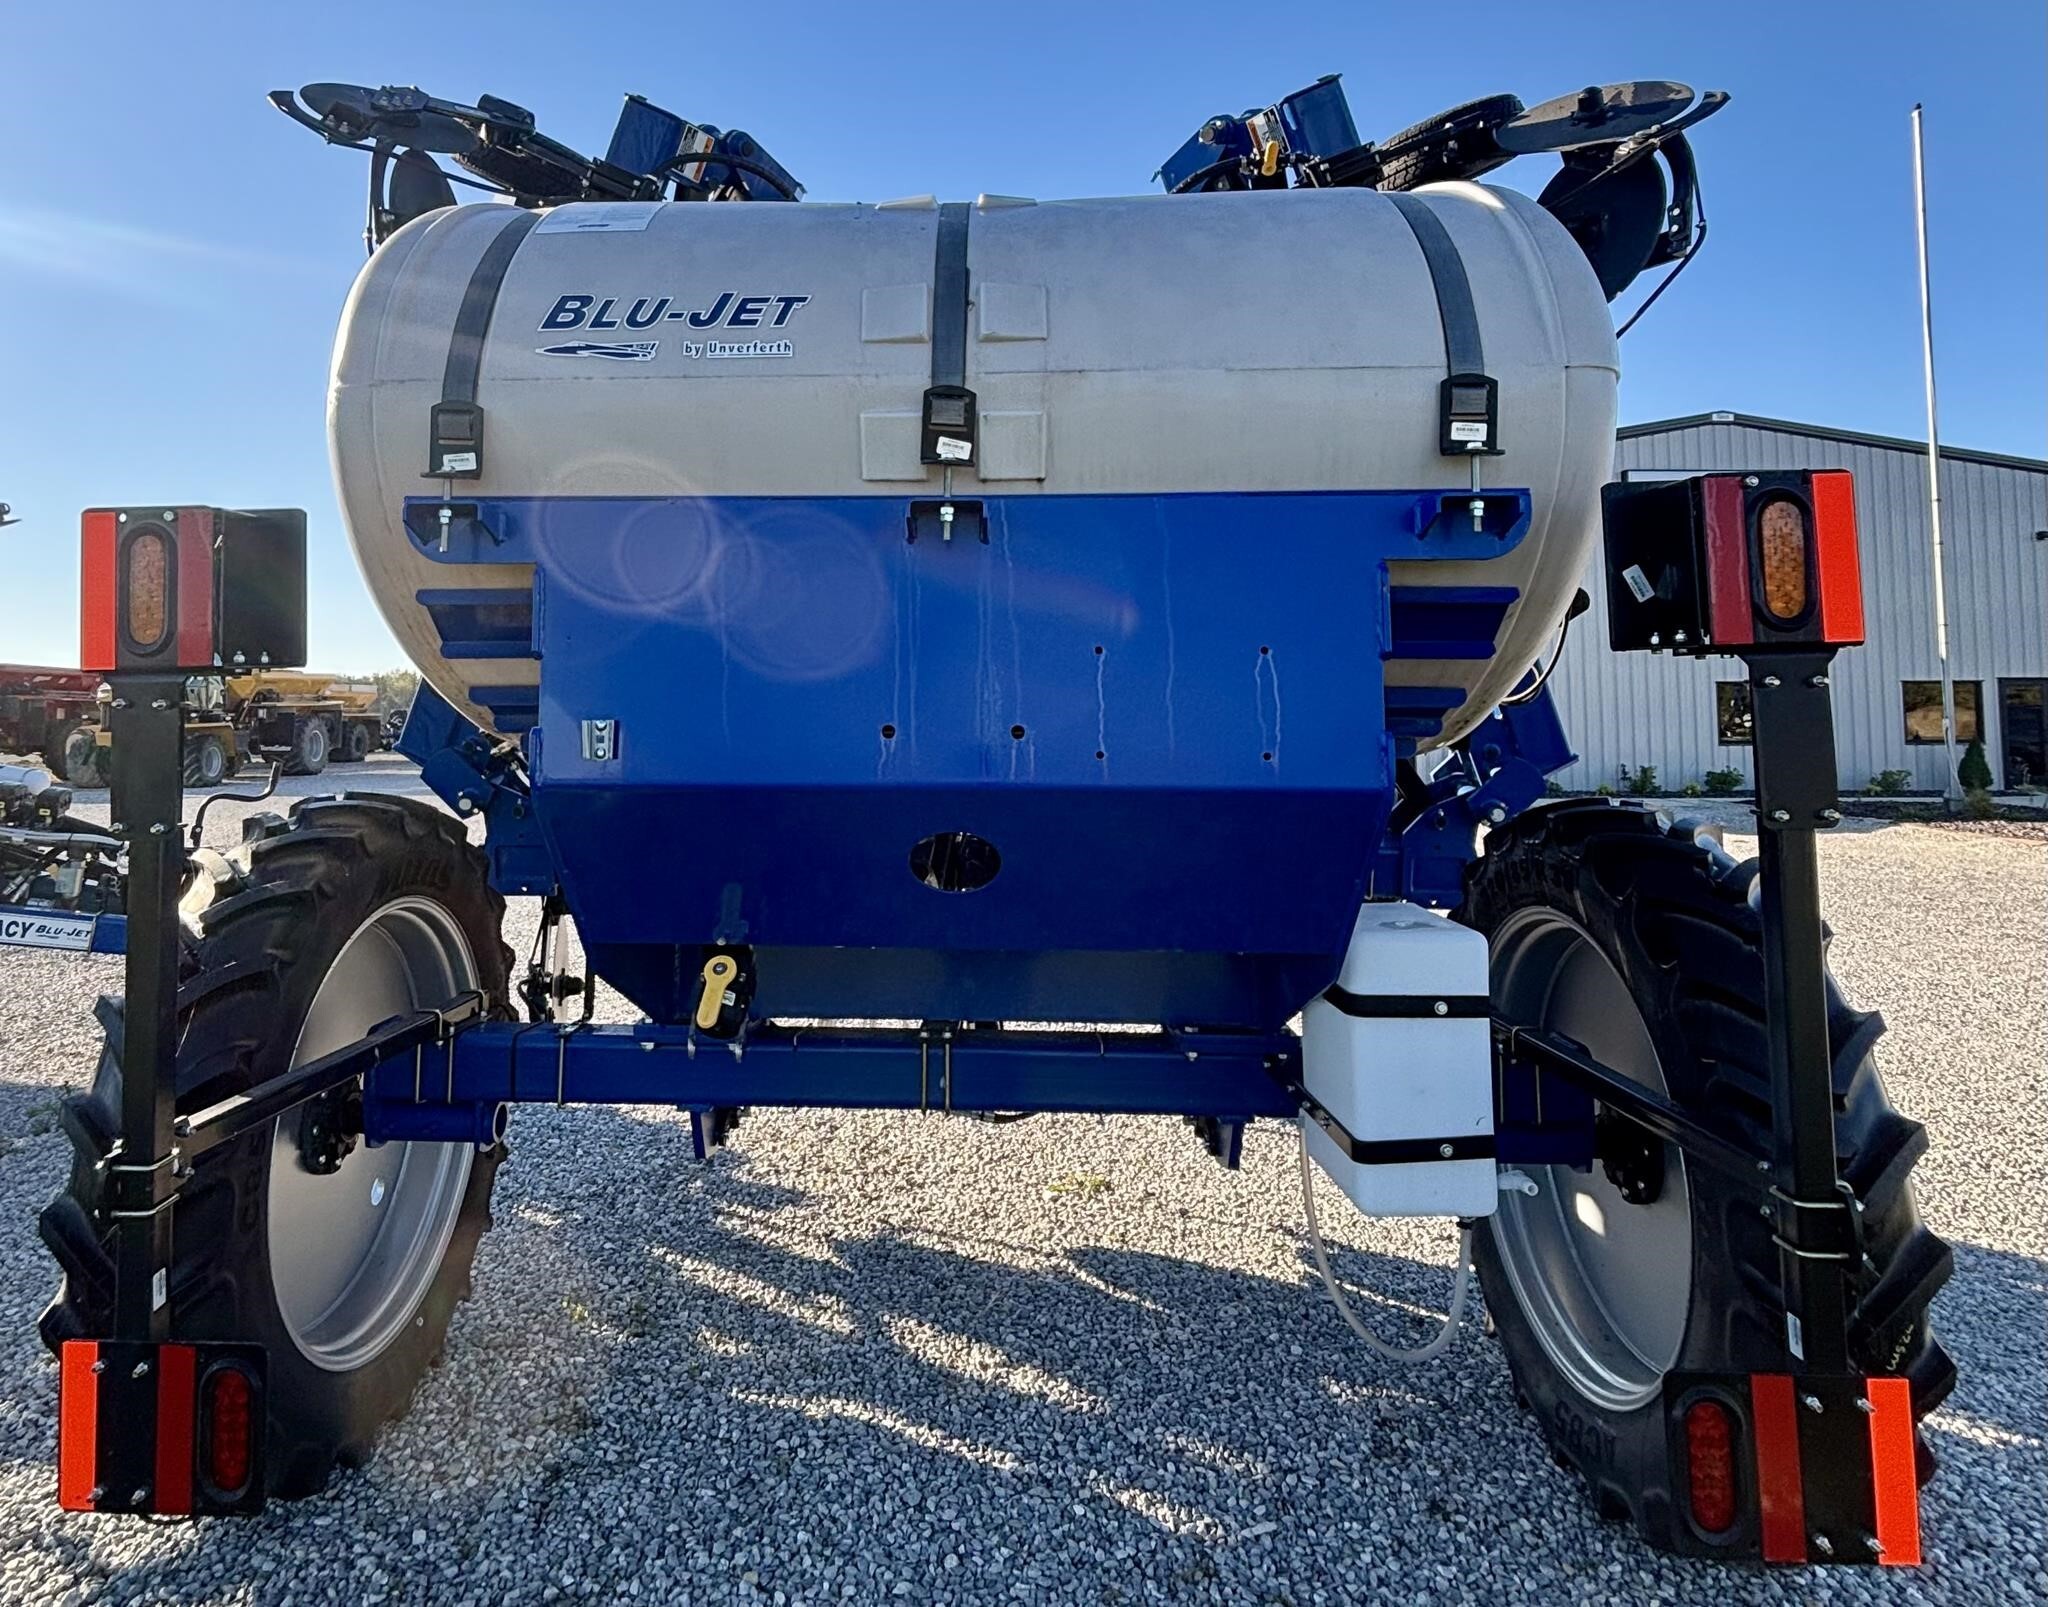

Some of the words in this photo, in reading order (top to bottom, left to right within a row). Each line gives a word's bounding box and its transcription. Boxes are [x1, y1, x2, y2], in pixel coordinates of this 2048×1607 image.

[538, 292, 811, 331] BLU-JET
[683, 341, 702, 357] by
[708, 340, 792, 356] Unverferth
[0, 919, 35, 939] CY
